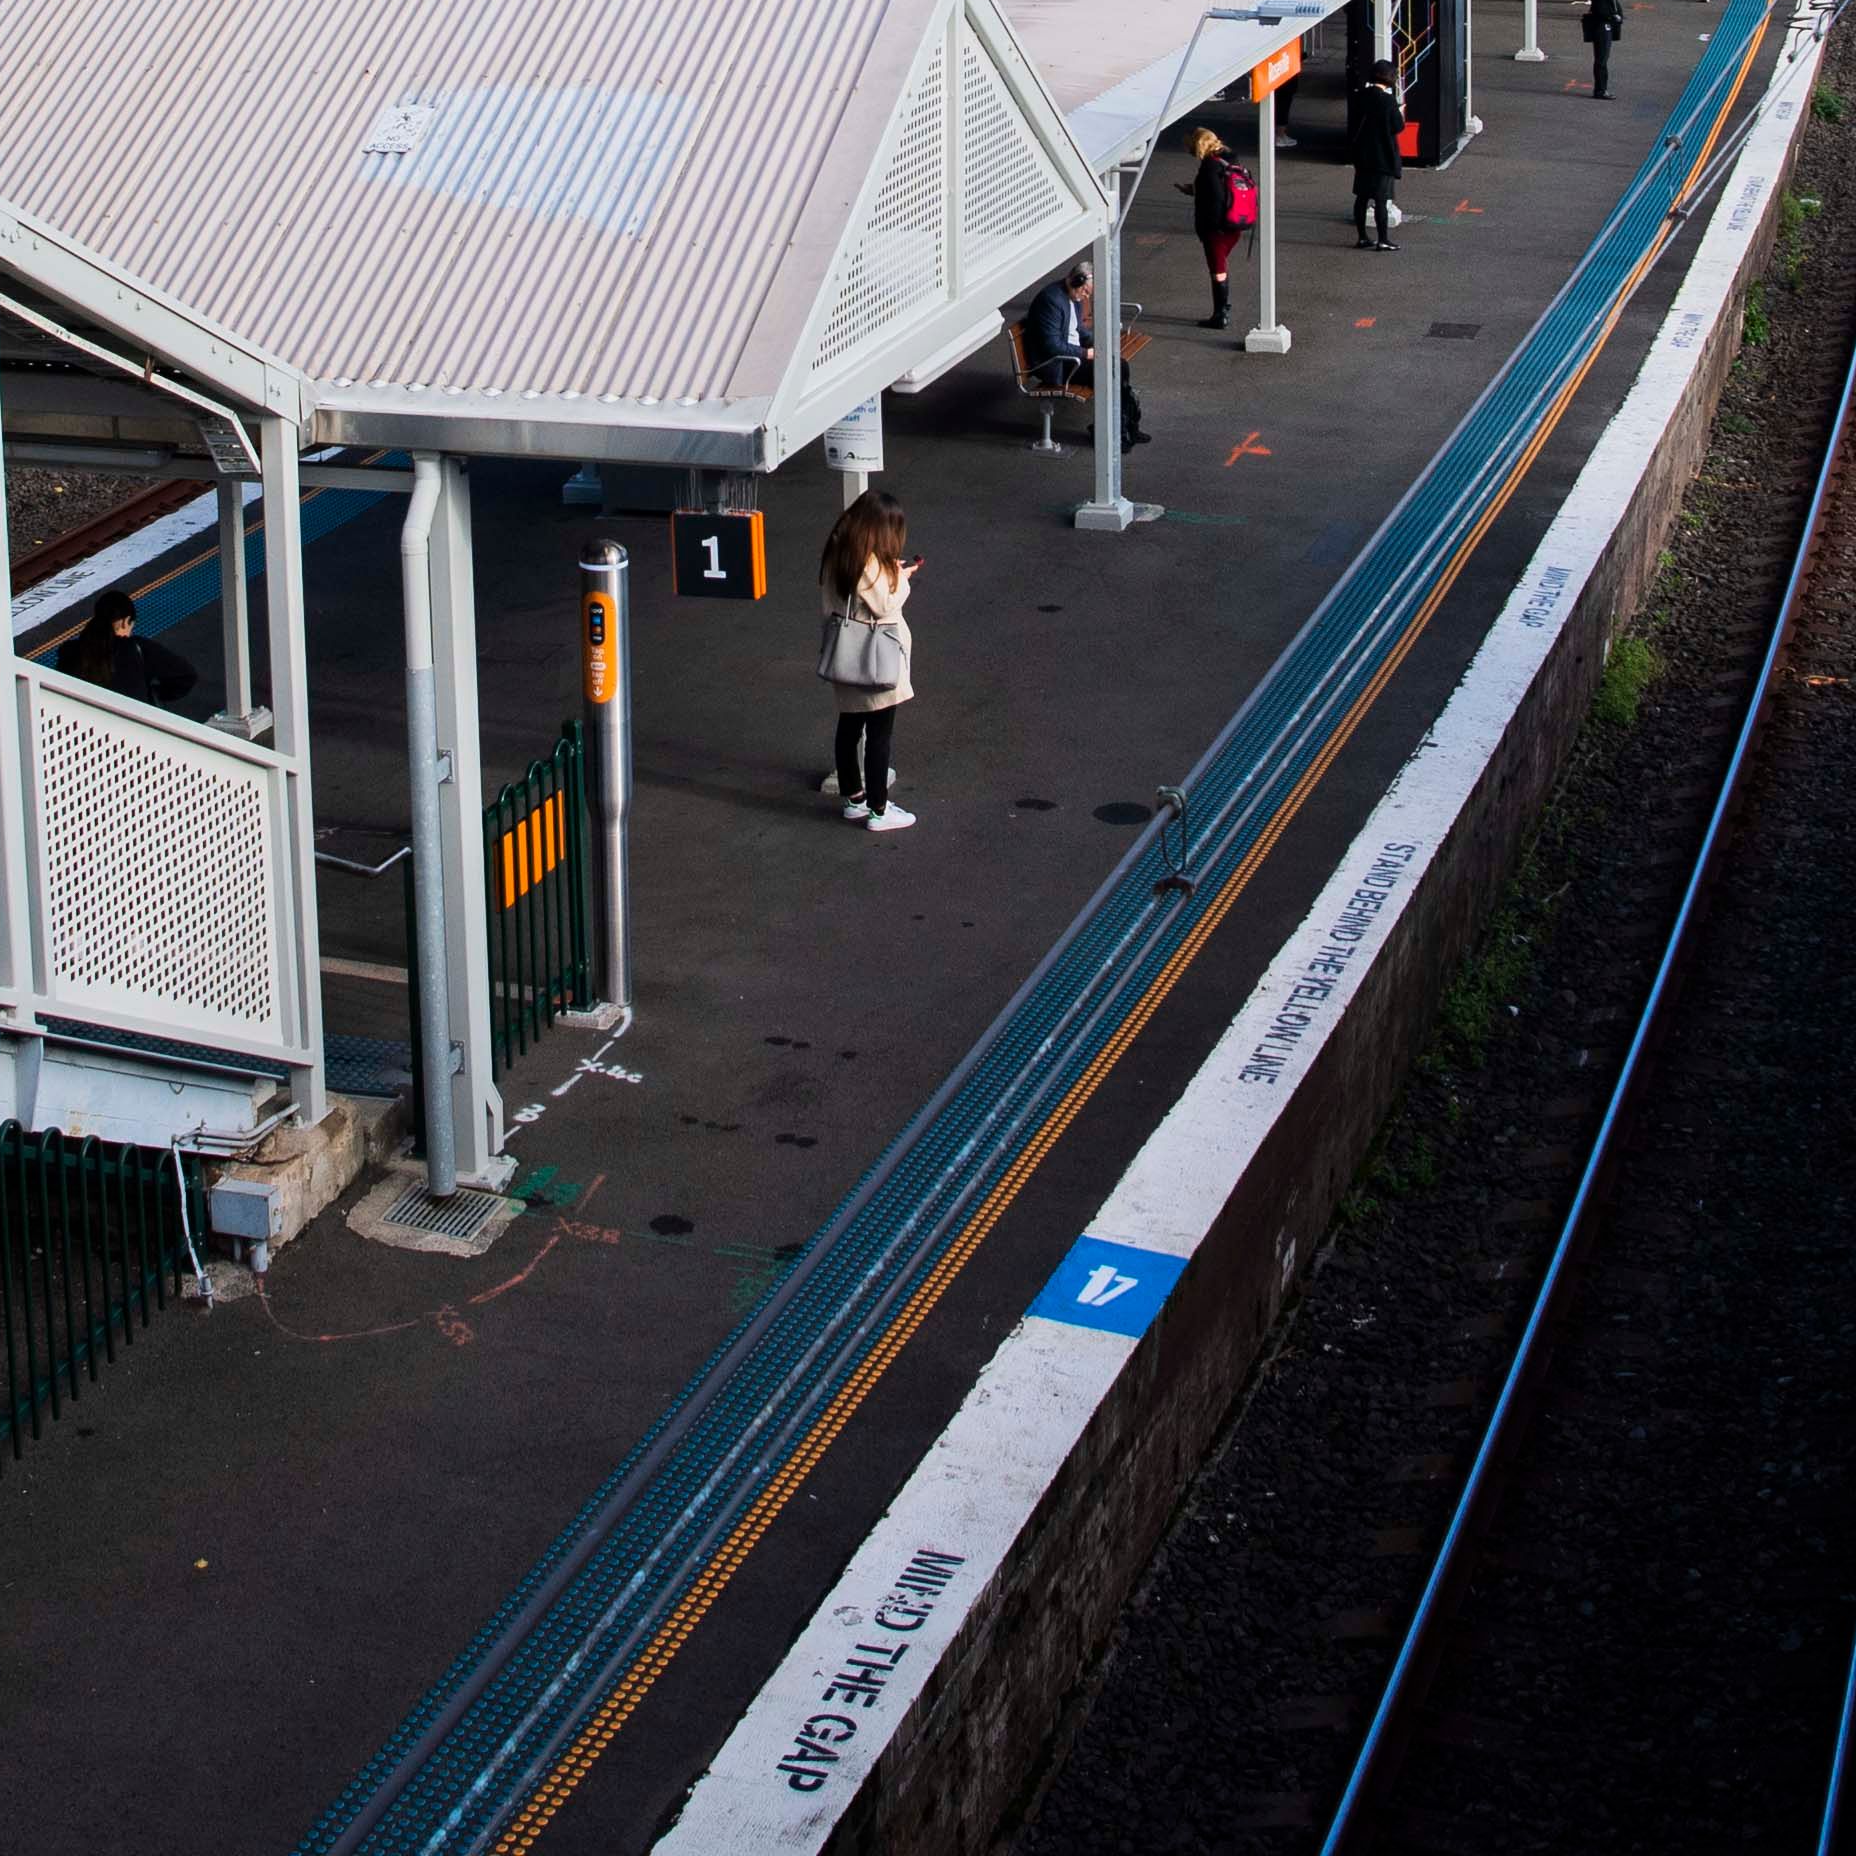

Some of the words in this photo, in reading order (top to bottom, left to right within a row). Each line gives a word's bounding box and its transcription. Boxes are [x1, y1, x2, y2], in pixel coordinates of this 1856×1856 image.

[47, 571, 95, 589] LINE
[700, 535, 727, 579] 1
[1364, 842, 1416, 889] STAND
[1330, 889, 1389, 942] BEHIND
[1308, 945, 1356, 975] THE
[1265, 977, 1338, 1044] YELLOW
[1238, 1044, 1293, 1085] LINE
[1076, 1264, 1138, 1307] 4
[875, 1548, 965, 1632] MIND
[822, 1642, 910, 1708] THE
[775, 1713, 855, 1793] GAP
